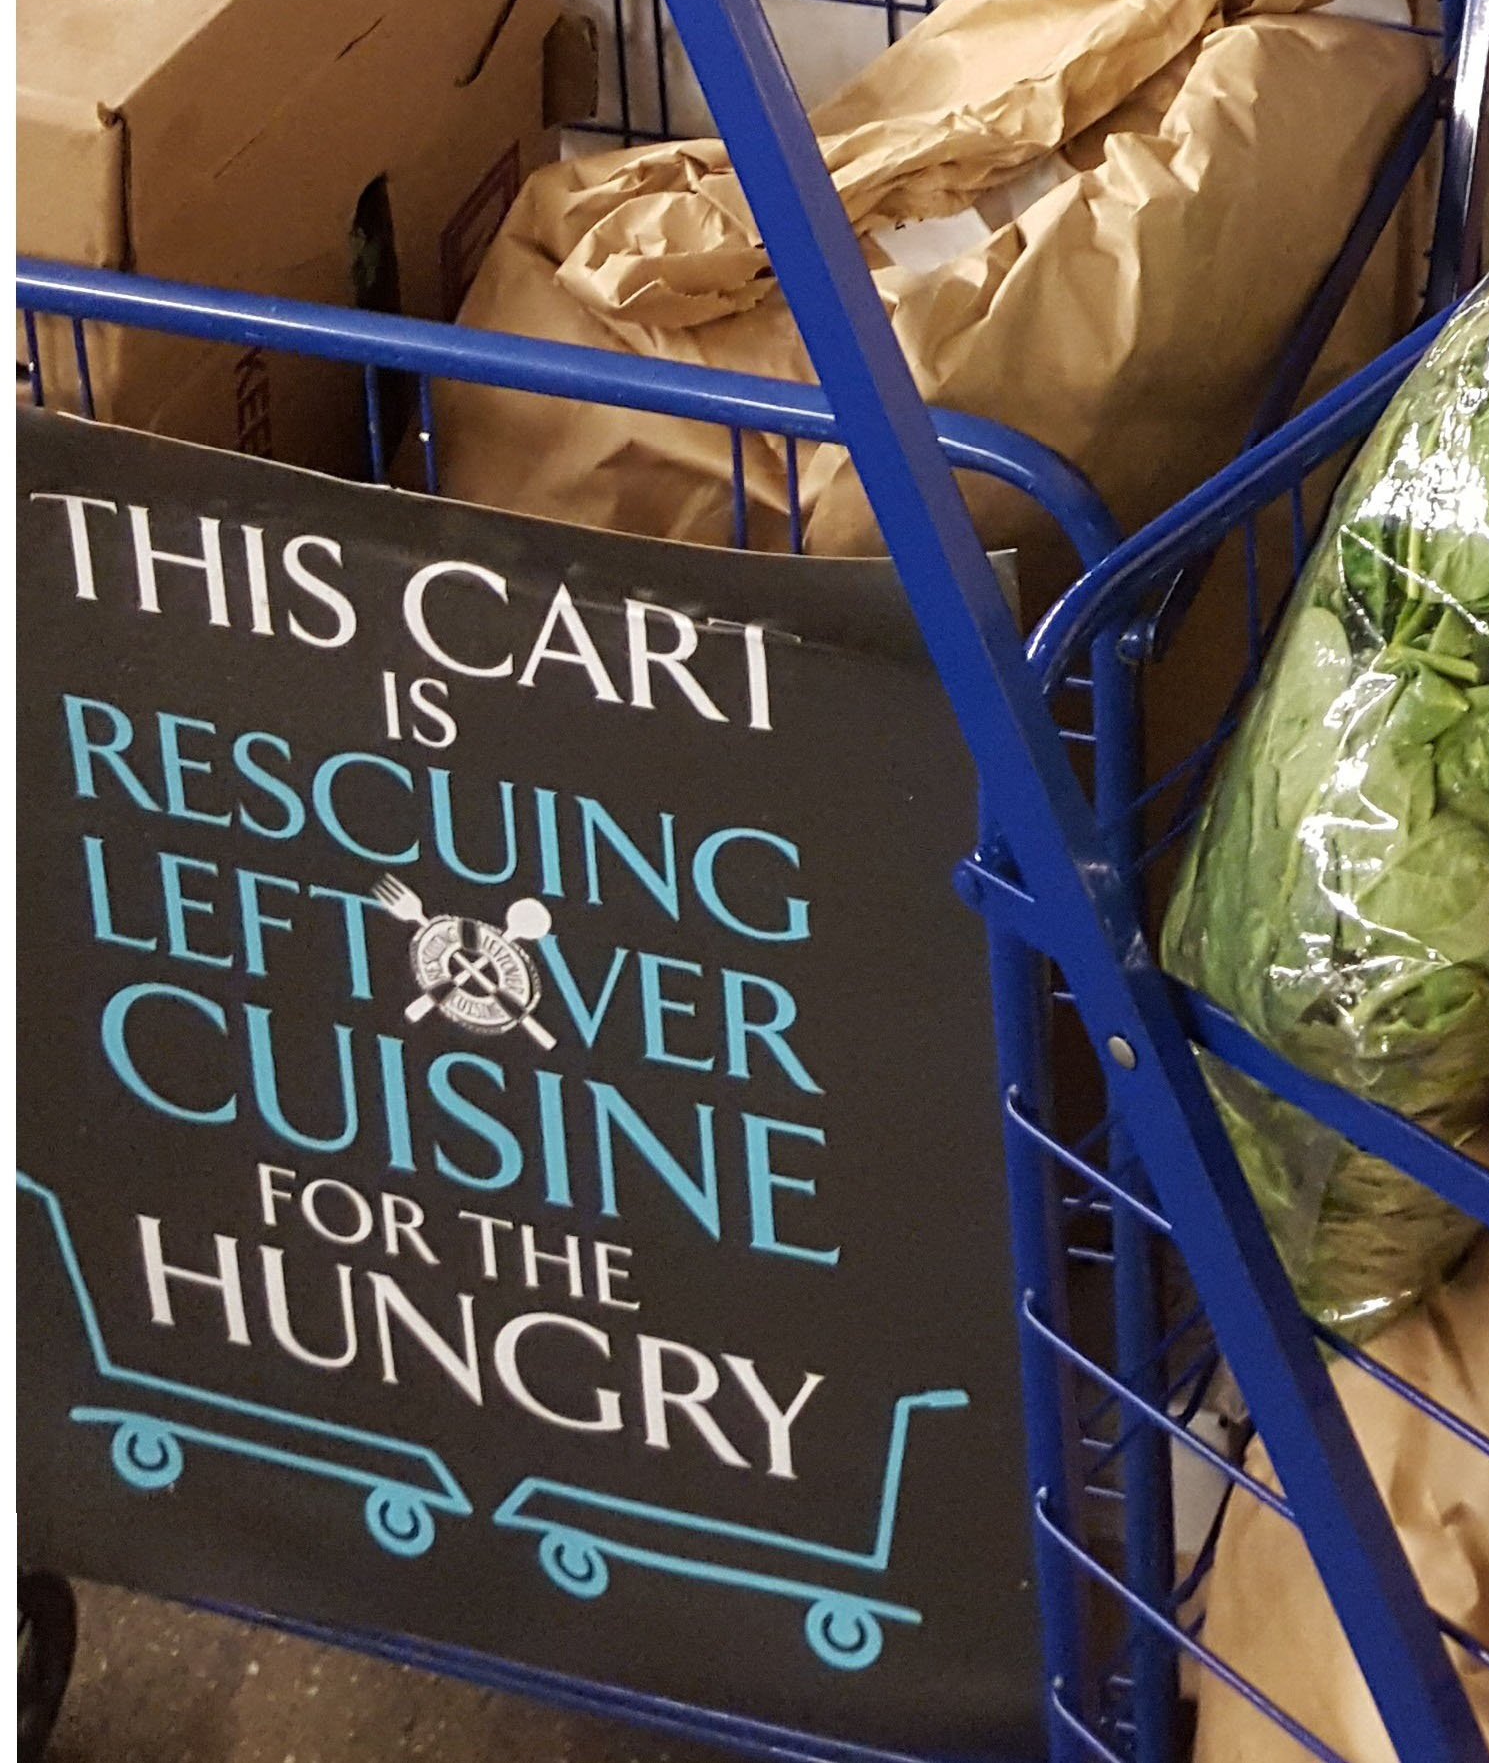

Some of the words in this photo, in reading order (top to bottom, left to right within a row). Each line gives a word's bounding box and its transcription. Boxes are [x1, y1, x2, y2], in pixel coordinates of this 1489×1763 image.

[234, 346, 273, 458] KEE
[30, 493, 357, 649] THIS
[403, 559, 802, 732] CART
[382, 670, 458, 749] IS
[63, 693, 811, 942] RESCUING
[101, 982, 841, 1266] CUISINE
[257, 1162, 441, 1266] FOR
[458, 1210, 641, 1311] THE
[136, 1214, 825, 1480] HUNGRY
